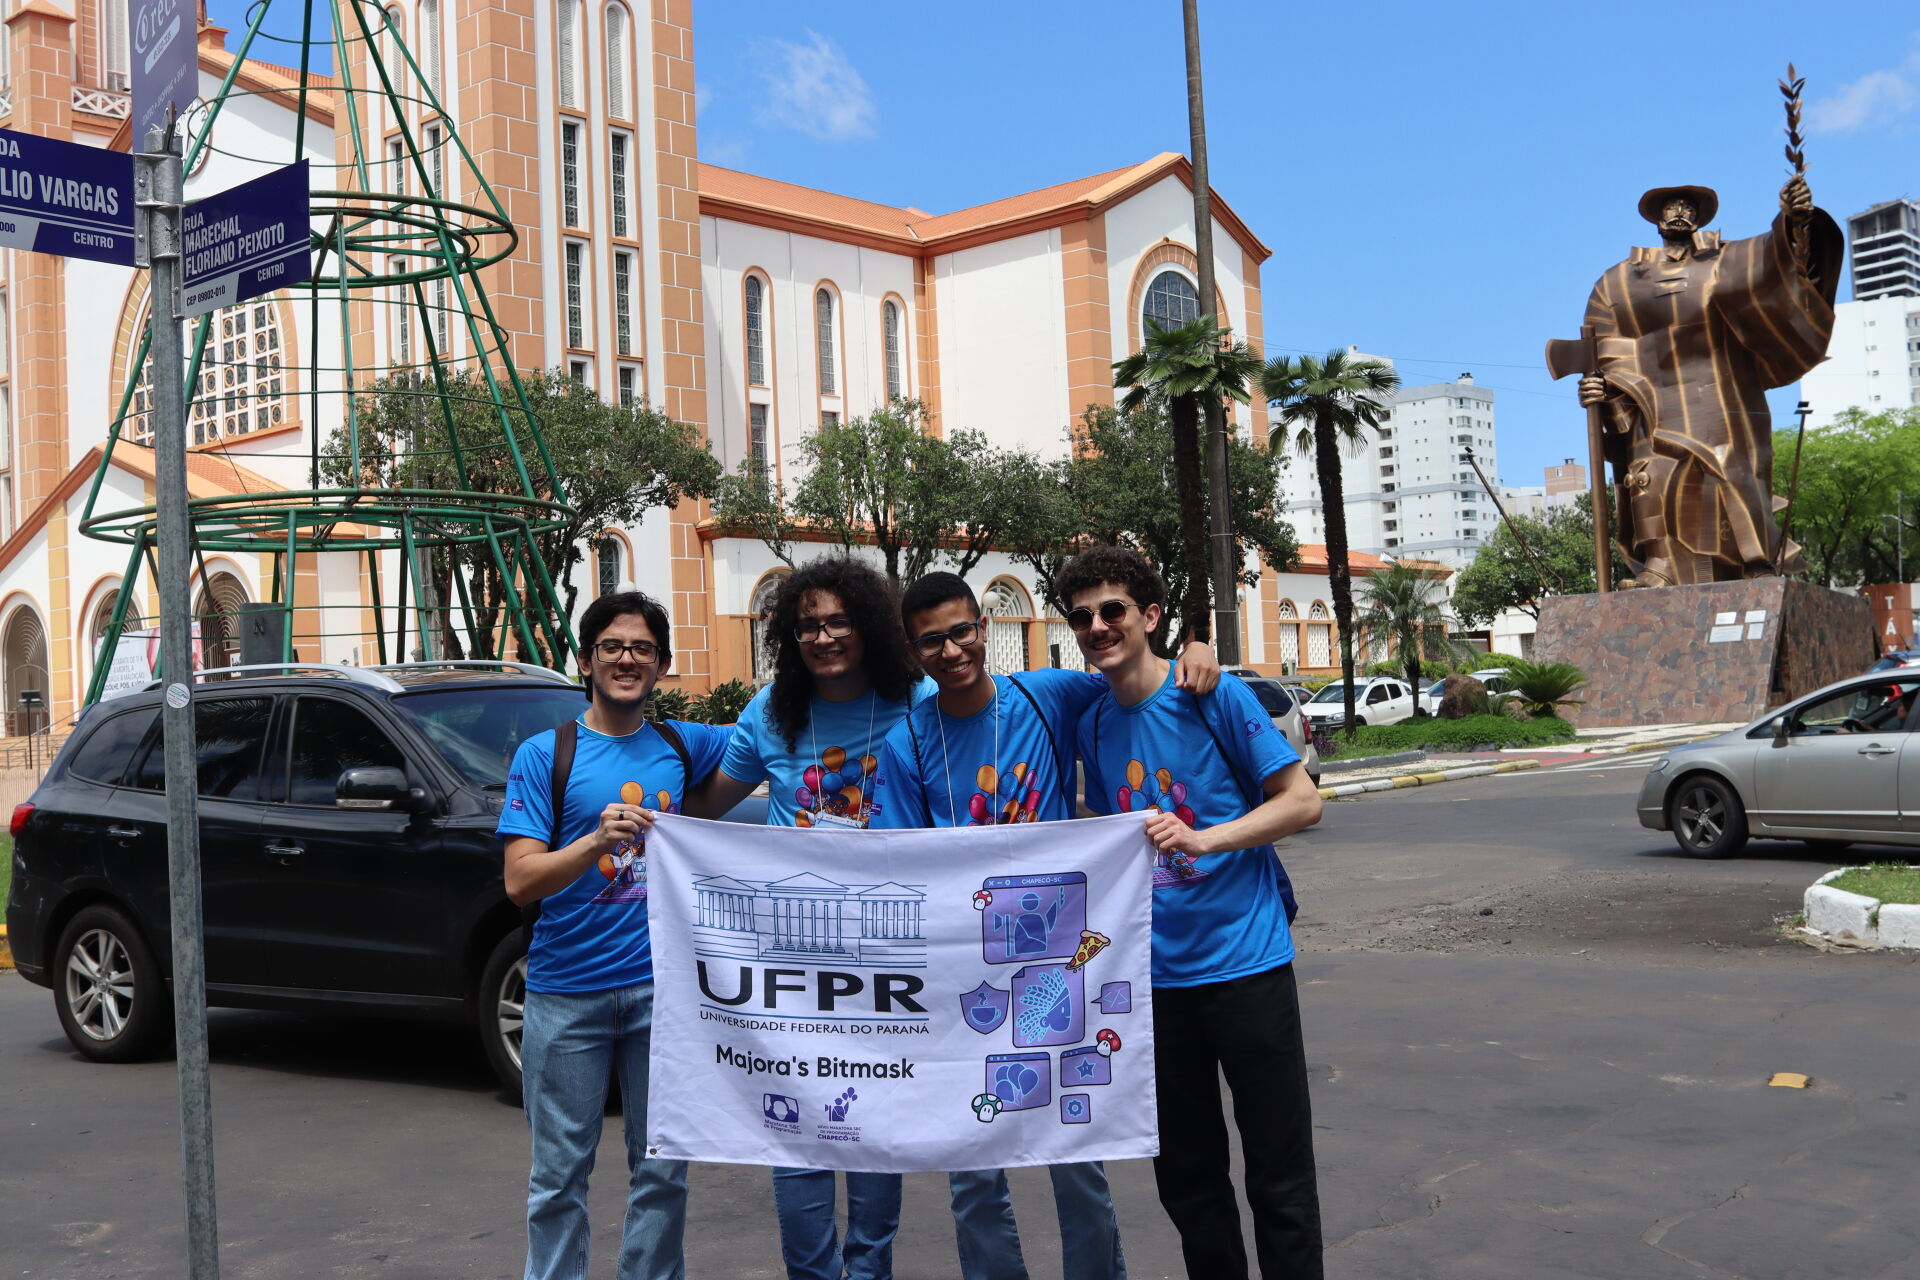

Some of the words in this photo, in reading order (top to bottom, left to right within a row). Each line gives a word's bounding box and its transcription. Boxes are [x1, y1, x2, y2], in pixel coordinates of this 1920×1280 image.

[0, 167, 33, 201] LIO
[39, 174, 119, 216] VARGAS
[184, 212, 204, 233] RUA
[73, 231, 114, 249] CENTRO
[185, 214, 241, 255] MARECHAL
[185, 240, 235, 278] FLORIANO
[238, 222, 285, 258] PEIXOTO
[257, 262, 285, 282] CENTRO
[186, 294, 196, 307] CEP
[1021, 876, 1063, 885] CHAPECÓ-SC
[696, 959, 929, 1013] UFPR
[700, 1010, 786, 1032] UNIVERSIDADE
[790, 1022, 846, 1034] FEDERAL
[850, 1024, 872, 1034] DO
[876, 1022, 930, 1035] PARANÁ
[716, 1043, 809, 1077] Majora's
[816, 1056, 915, 1079] Bitmask
[764, 1119, 788, 1128] Maratona
[817, 1134, 861, 1142] CHAPECÓ-SC
